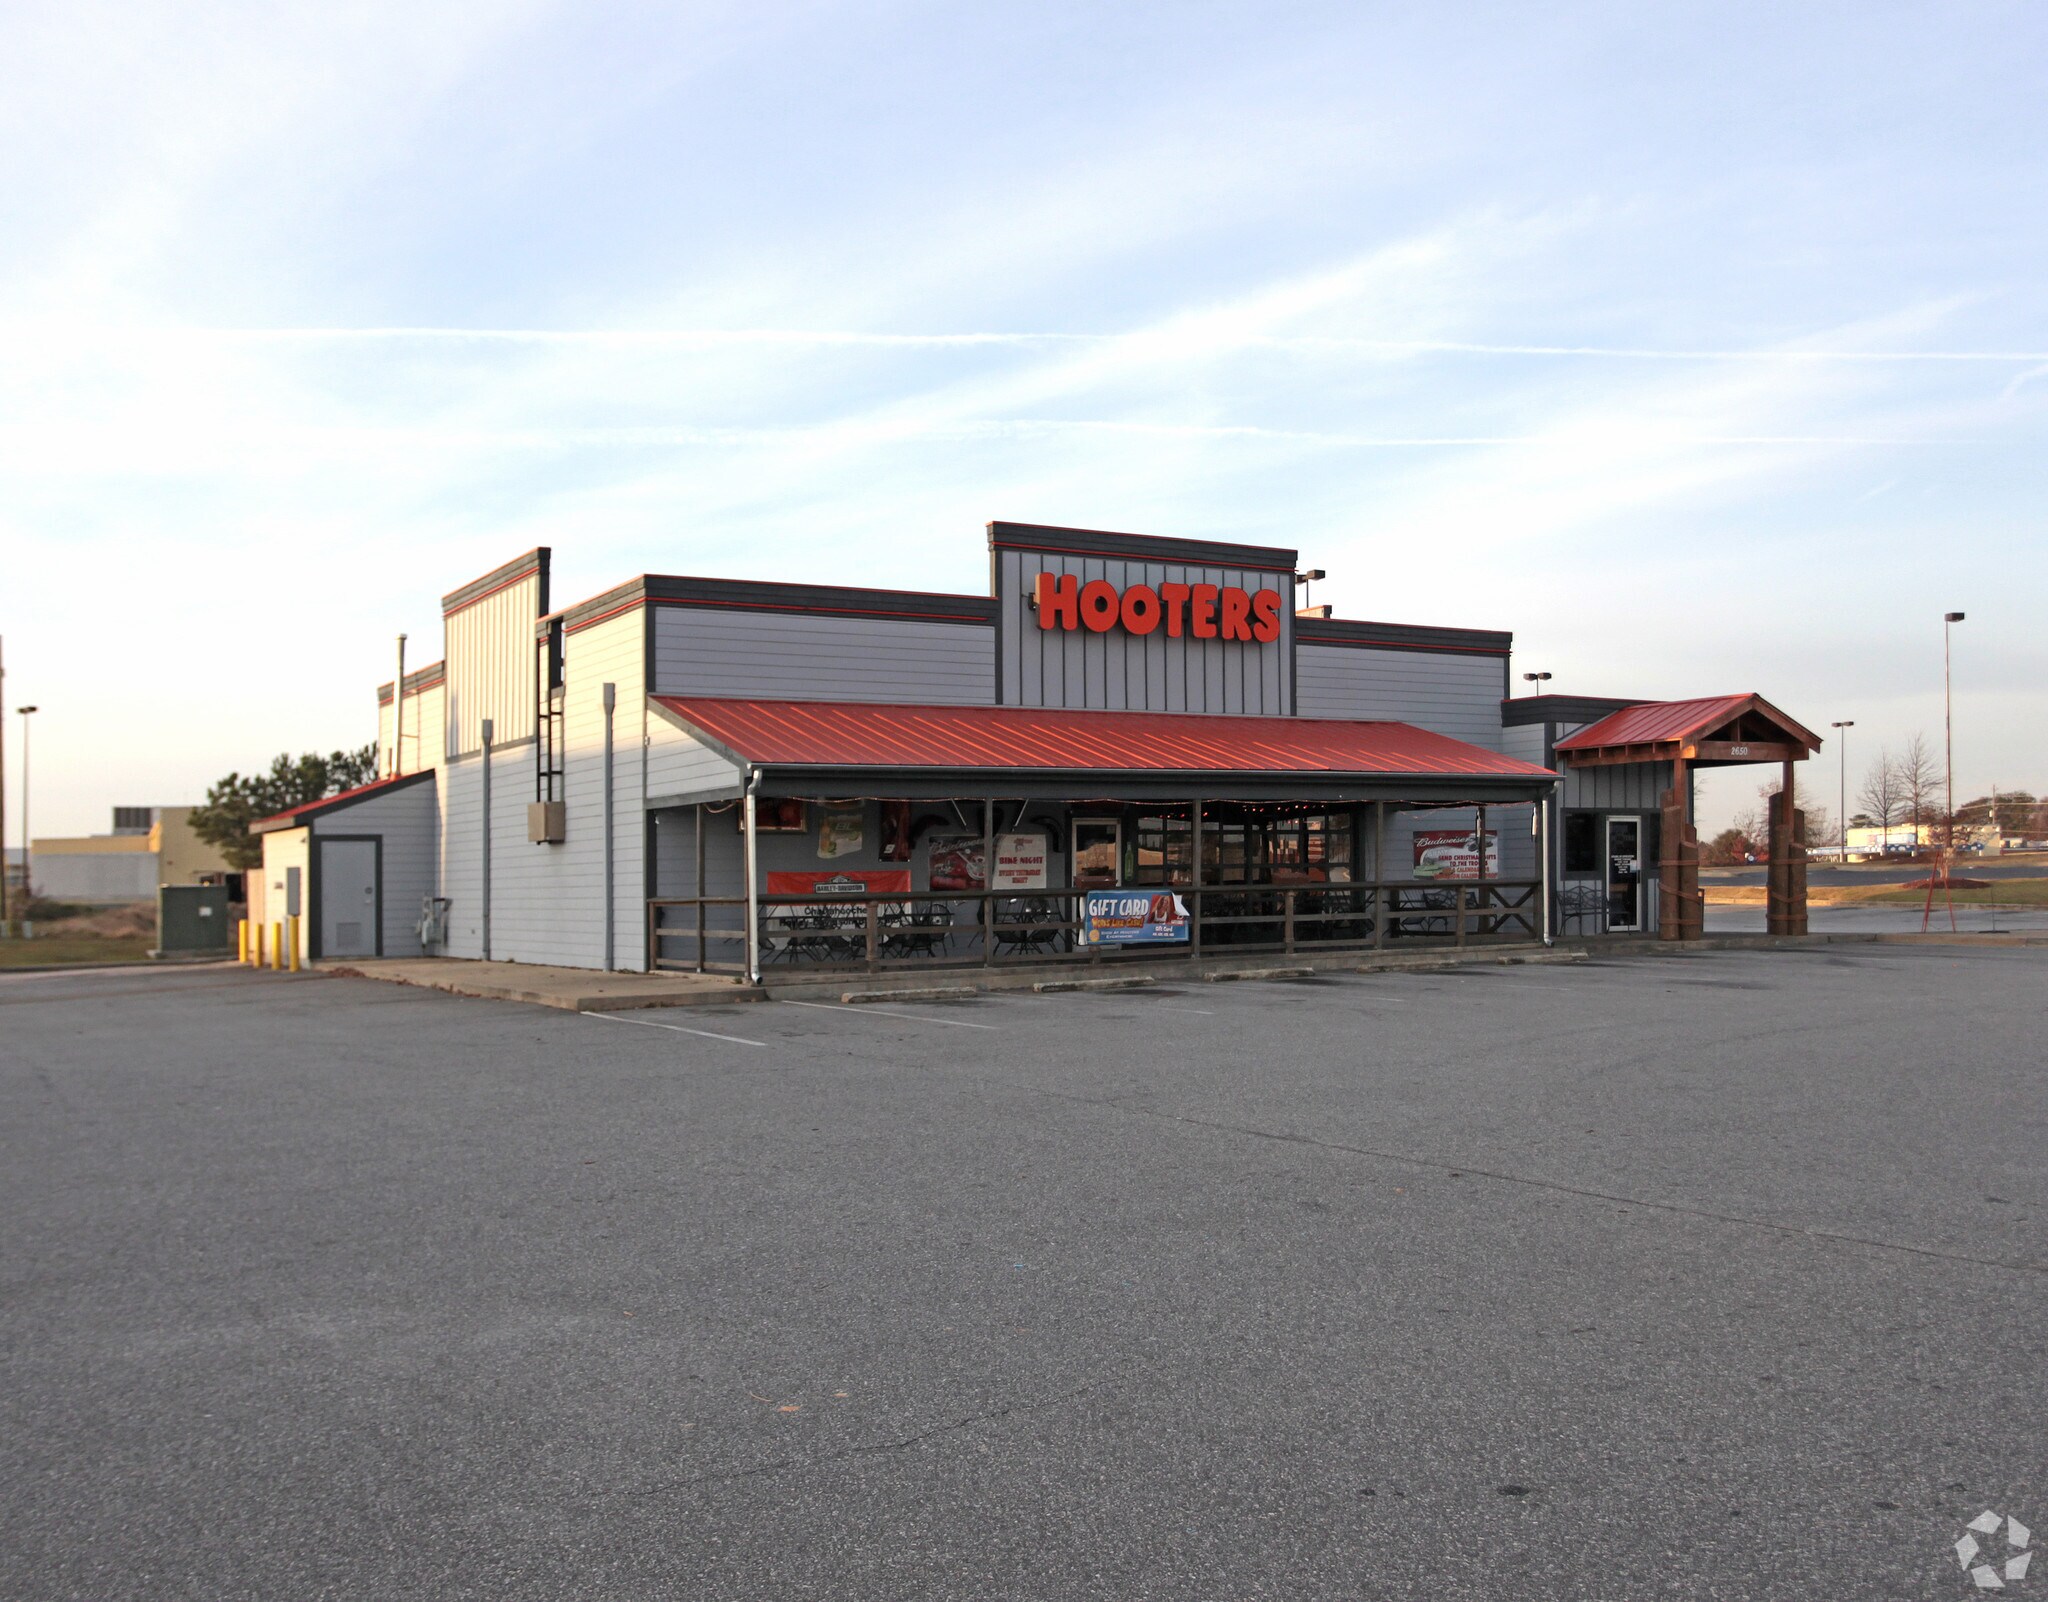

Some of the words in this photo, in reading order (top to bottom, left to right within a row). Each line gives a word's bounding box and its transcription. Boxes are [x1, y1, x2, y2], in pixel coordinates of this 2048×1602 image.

[1036, 572, 1282, 643] HOOTERS
[1731, 746, 1748, 756] 2650
[1415, 837, 1472, 848] Budweiser
[998, 856, 1017, 864] BIKE
[1020, 856, 1043, 864] NIGHT
[1088, 899, 1118, 917] GIFT
[1119, 899, 1149, 917] CARD
